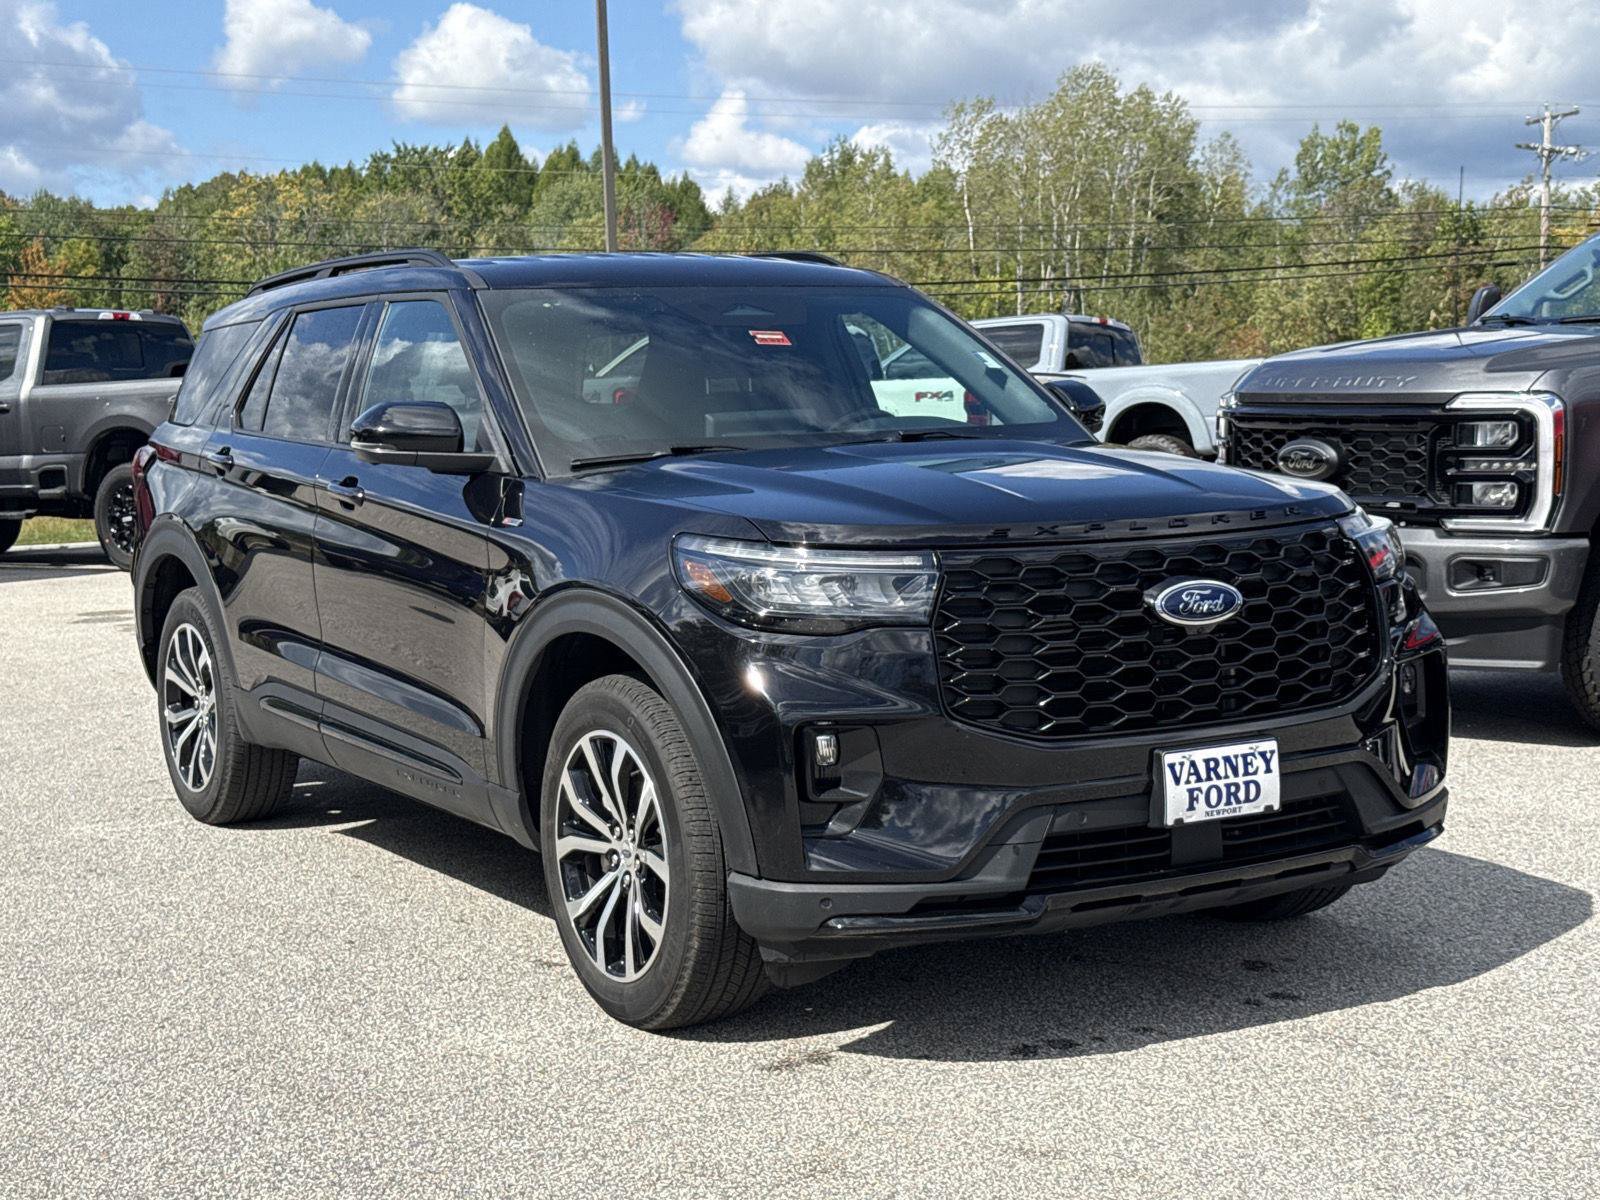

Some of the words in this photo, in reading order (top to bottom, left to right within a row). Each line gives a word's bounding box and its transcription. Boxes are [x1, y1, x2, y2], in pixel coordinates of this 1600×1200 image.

[1287, 451, 1316, 471] Ford
[1179, 589, 1225, 614] Ford
[1167, 750, 1275, 786] VARNEY
[1186, 779, 1261, 812] FORD
[1204, 806, 1242, 818] NEWPORT
